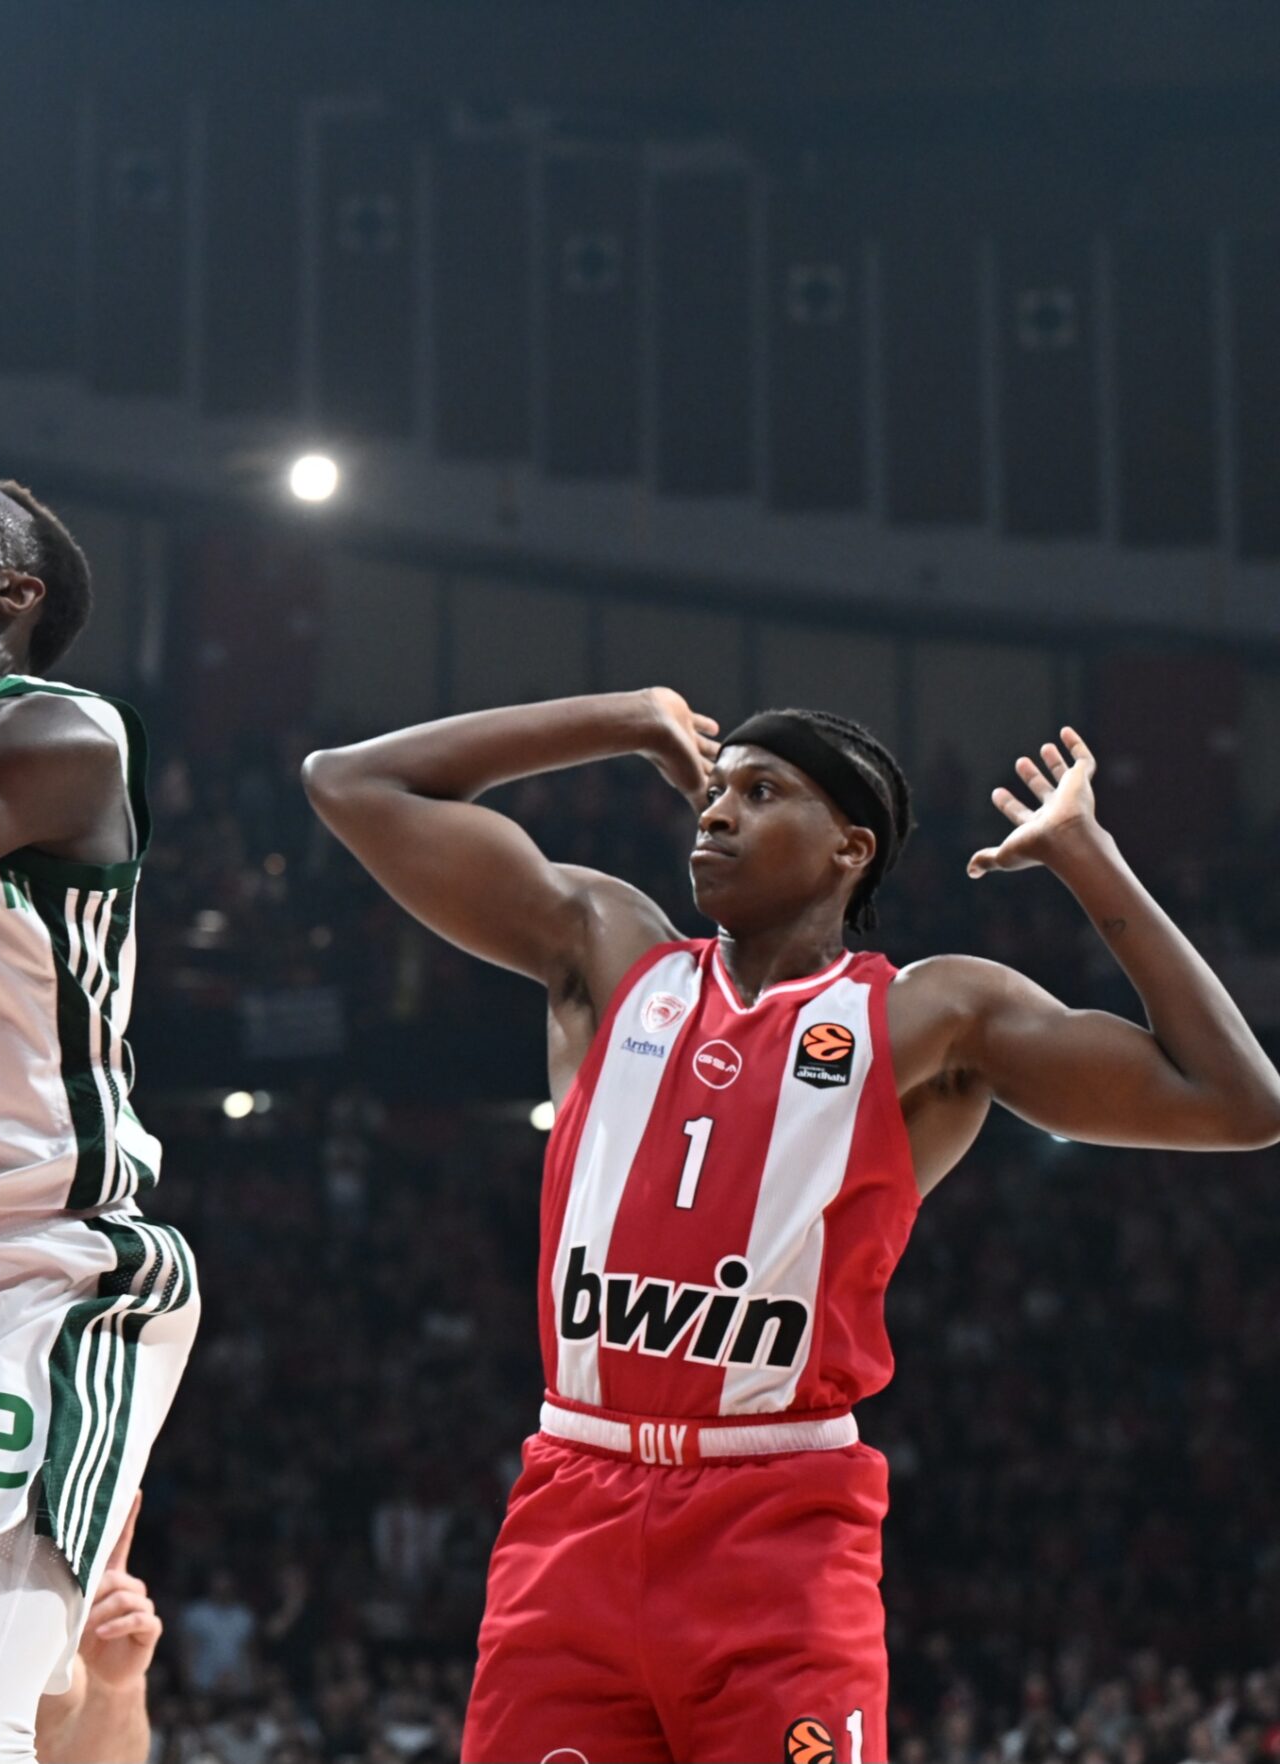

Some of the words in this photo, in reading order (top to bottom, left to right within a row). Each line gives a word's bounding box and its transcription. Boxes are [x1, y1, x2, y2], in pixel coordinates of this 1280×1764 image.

[674, 1116, 715, 1210] 1
[560, 1244, 812, 1370] bwin
[638, 1423, 690, 1466] OLY
